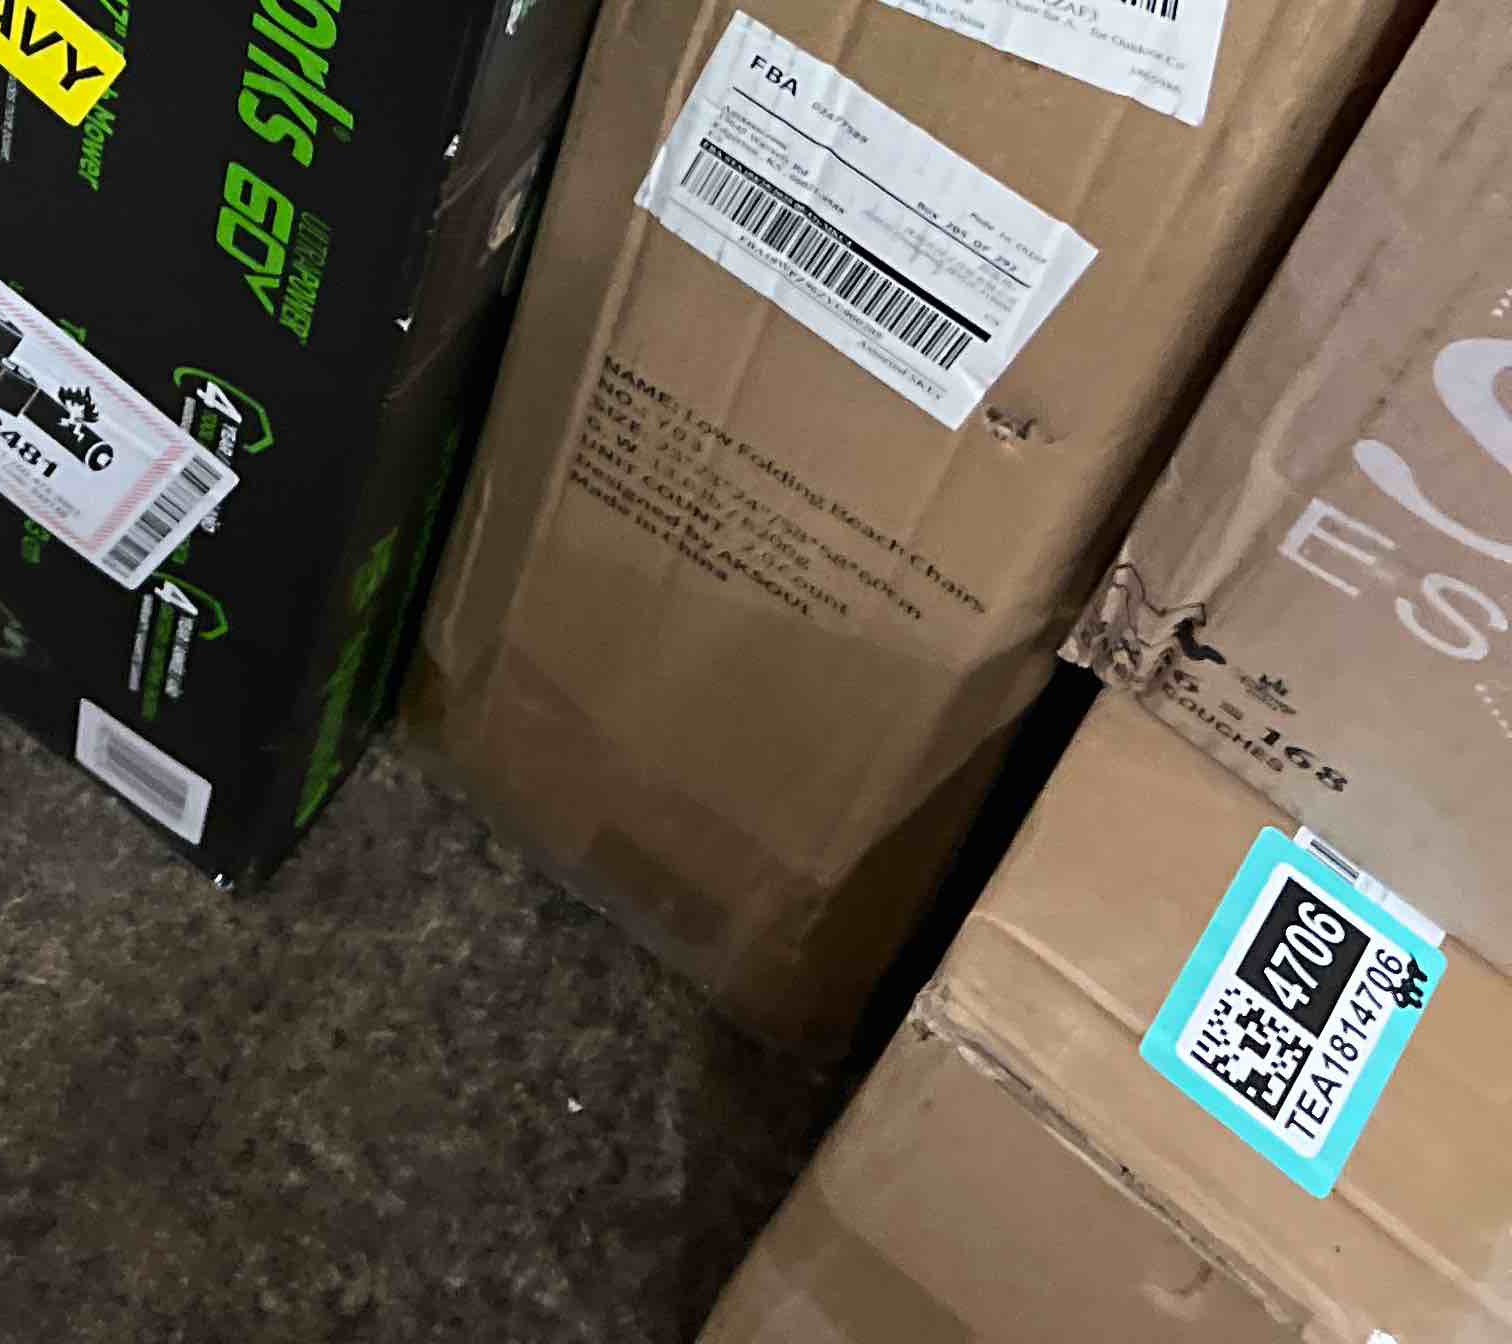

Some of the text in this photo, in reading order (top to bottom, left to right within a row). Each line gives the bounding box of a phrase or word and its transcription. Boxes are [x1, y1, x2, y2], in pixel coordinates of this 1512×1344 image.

[748, 53, 800, 97] FBA
[76, 91, 115, 195] Mower
[217, 164, 293, 310] 60V
[275, 207, 334, 344] ULTRAPOWER
[194, 370, 243, 427] 4
[217, 420, 237, 457] YEAR
[565, 468, 634, 516] Made
[575, 452, 680, 527] Designed
[642, 475, 722, 531] COUNT
[737, 443, 823, 506] Folding
[830, 503, 904, 555] Beach
[153, 575, 198, 624] 4
[1261, 727, 1347, 791] 168
[1265, 902, 1344, 1008] 4706
[1285, 949, 1412, 1137] TEA1814706
